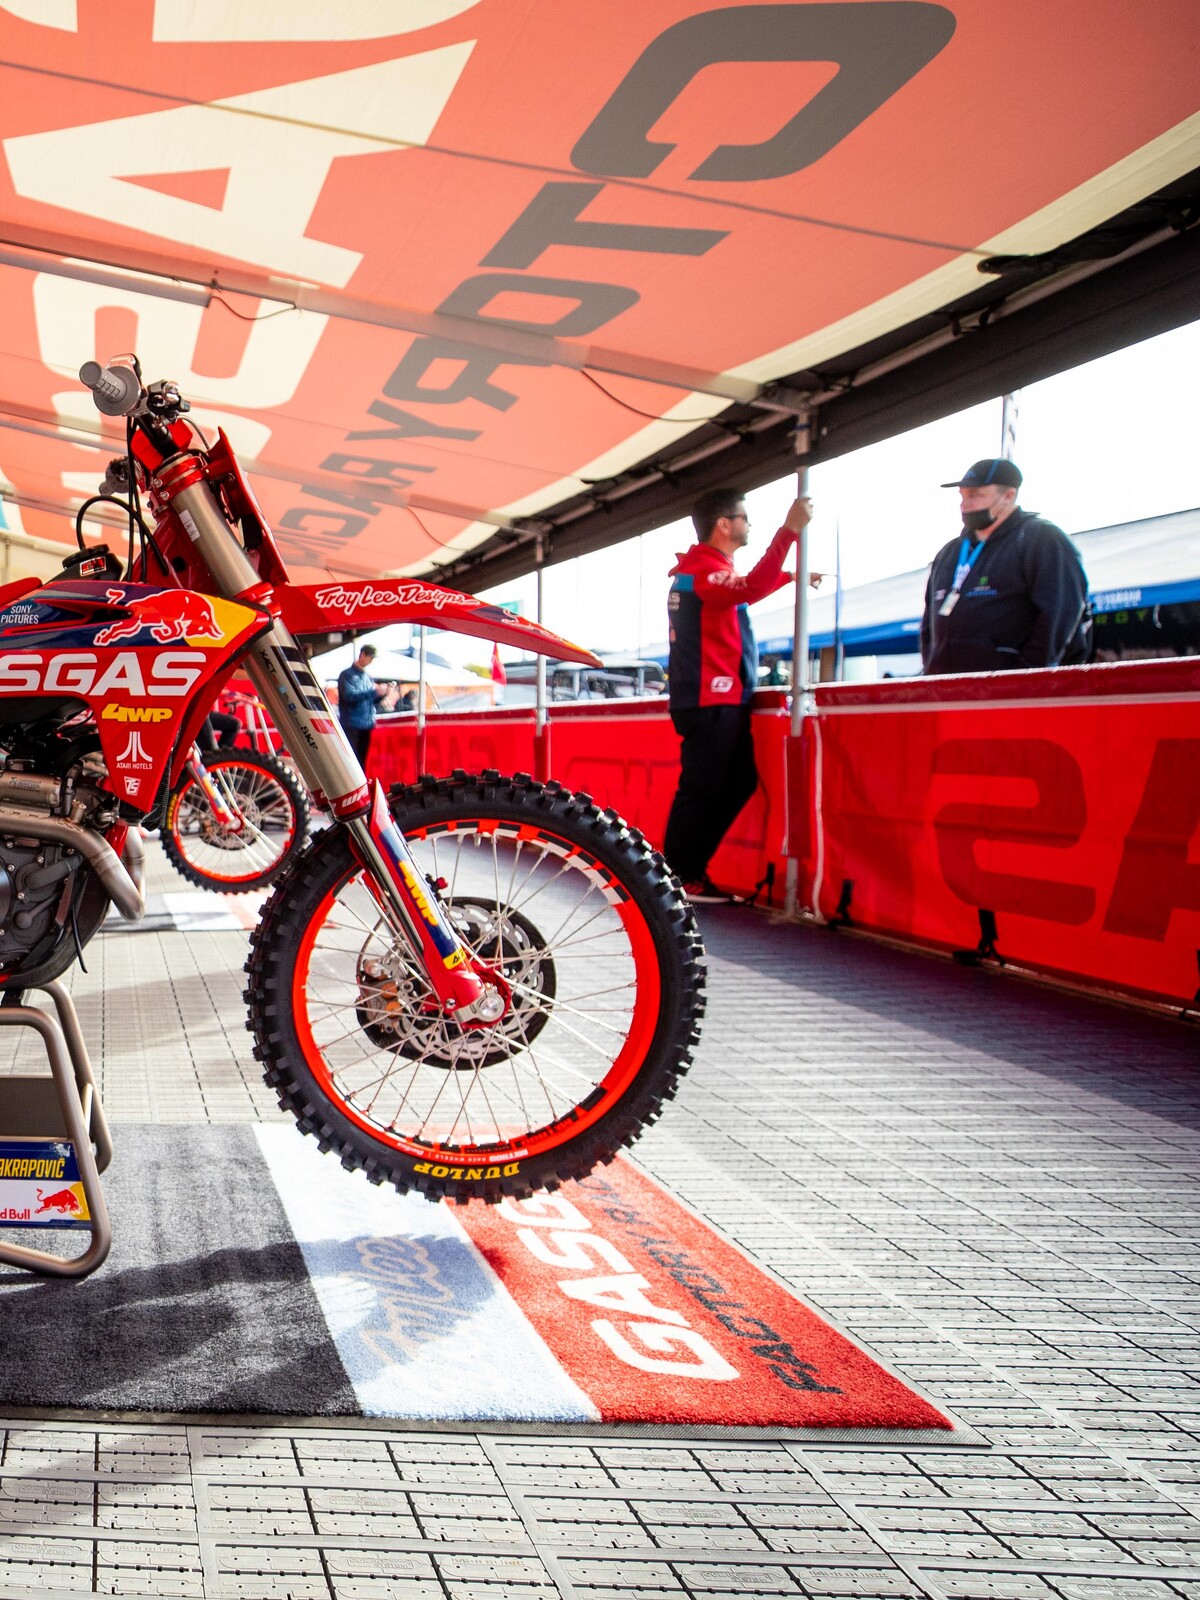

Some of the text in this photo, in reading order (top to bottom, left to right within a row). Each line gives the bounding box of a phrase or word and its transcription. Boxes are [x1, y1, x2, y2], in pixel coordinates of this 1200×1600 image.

[315, 584, 481, 616] Troy Lee Designs
[10, 604, 32, 614] SONY
[0, 613, 39, 624] PICTURES
[101, 703, 173, 722] 4WP
[300, 726, 319, 751] SKF
[132, 762, 153, 770] HOTELS
[489, 1148, 529, 1163] METHOD
[413, 1161, 521, 1181] DUNLOP
[9, 1208, 30, 1220] Bull
